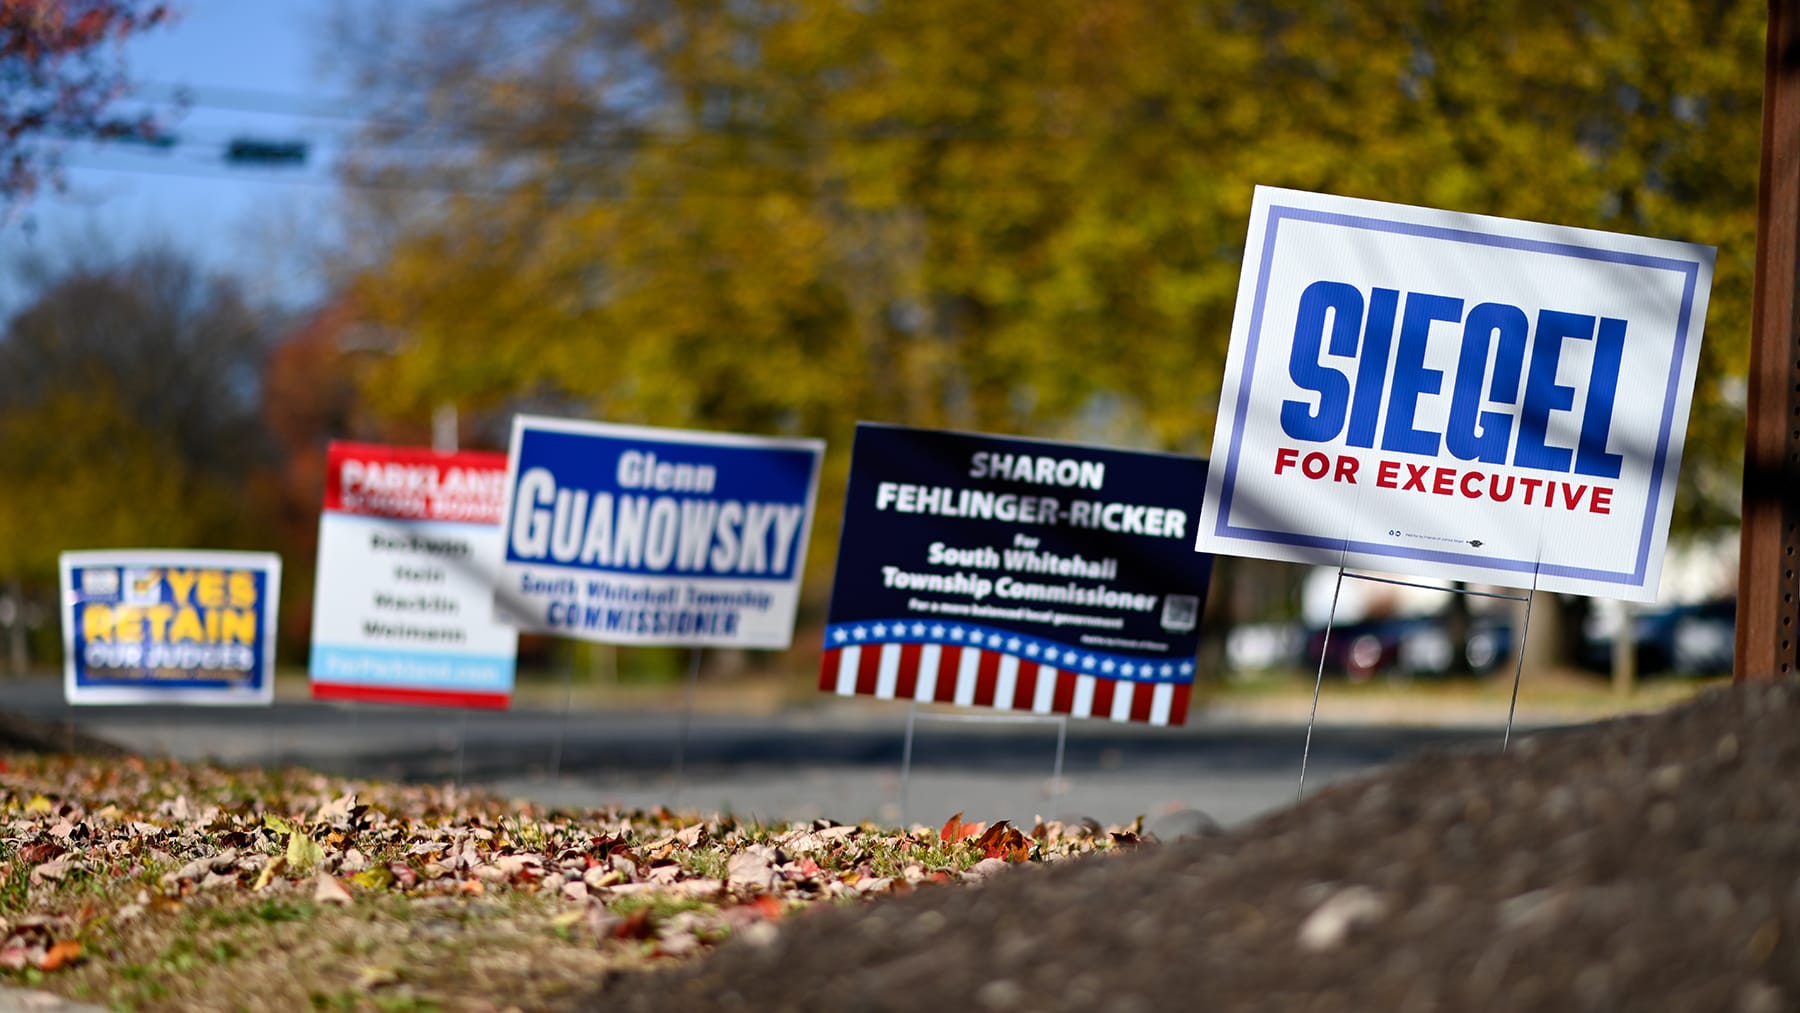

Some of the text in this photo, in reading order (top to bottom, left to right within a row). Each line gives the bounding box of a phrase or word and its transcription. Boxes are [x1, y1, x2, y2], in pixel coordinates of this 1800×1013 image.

[1280, 280, 1628, 479] SIEGEL
[617, 450, 717, 494] Glenn
[969, 452, 1104, 490] SHARON
[1274, 447, 1614, 515] FOR EXECUTIVE
[511, 467, 801, 573] GUANOWSKY
[876, 482, 1186, 538] FEHLINGER-RICKER
[928, 542, 1117, 580] South Whitehall
[1014, 533, 1040, 549] For
[167, 567, 257, 608] YES
[522, 573, 575, 594] South
[882, 566, 1157, 611] Township Commissioner
[84, 603, 257, 645] RETAIN
[549, 601, 740, 636] COMMISSIONER
